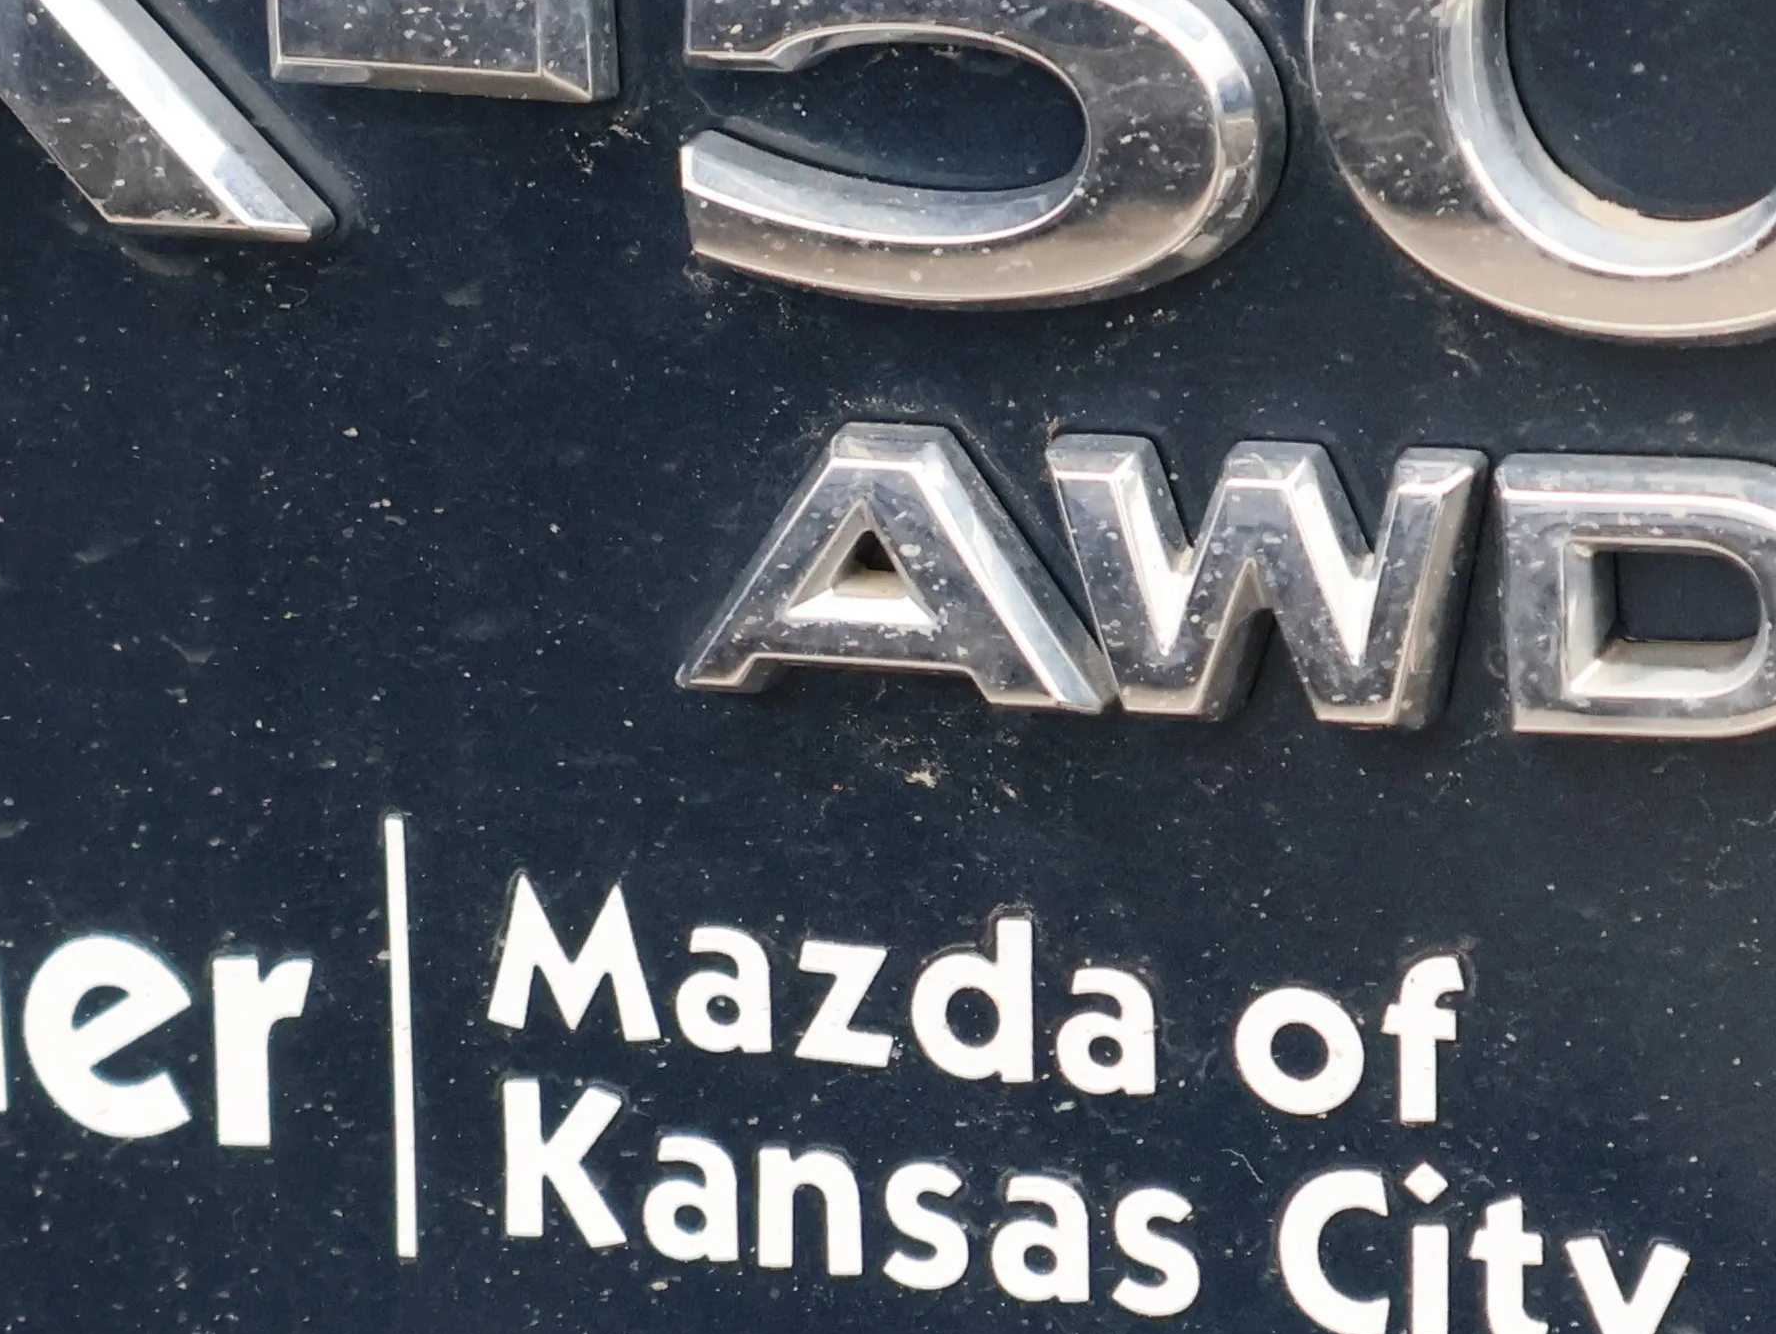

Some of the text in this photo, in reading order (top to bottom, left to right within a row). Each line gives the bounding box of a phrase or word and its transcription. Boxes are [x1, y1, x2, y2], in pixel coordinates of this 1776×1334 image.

[486, 872, 1466, 1124] Mazda of
[501, 1077, 1201, 1318] Kansas
